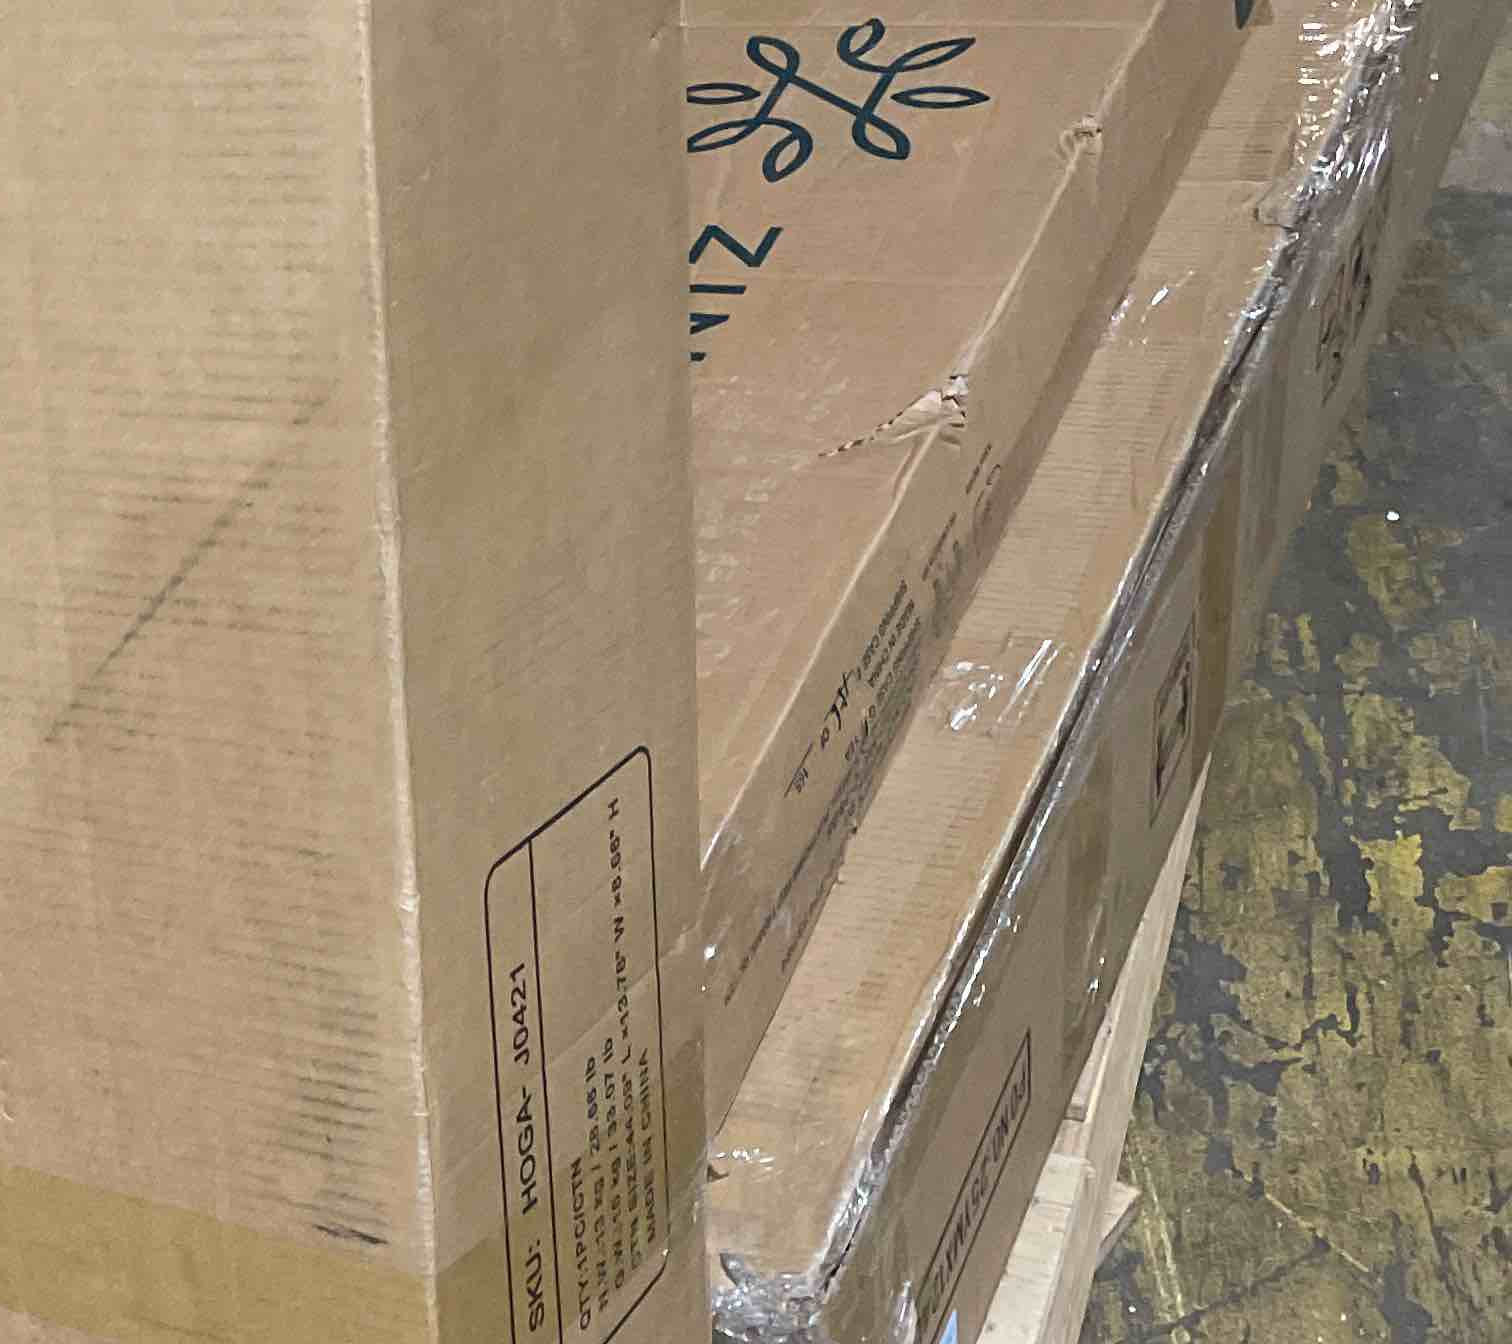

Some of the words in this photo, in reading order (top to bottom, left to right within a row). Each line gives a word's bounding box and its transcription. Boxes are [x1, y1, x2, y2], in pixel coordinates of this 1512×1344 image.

[509, 962, 530, 1065] J0421
[516, 1085, 538, 1215] HOGA-
[528, 1238, 545, 1333] SKU:
